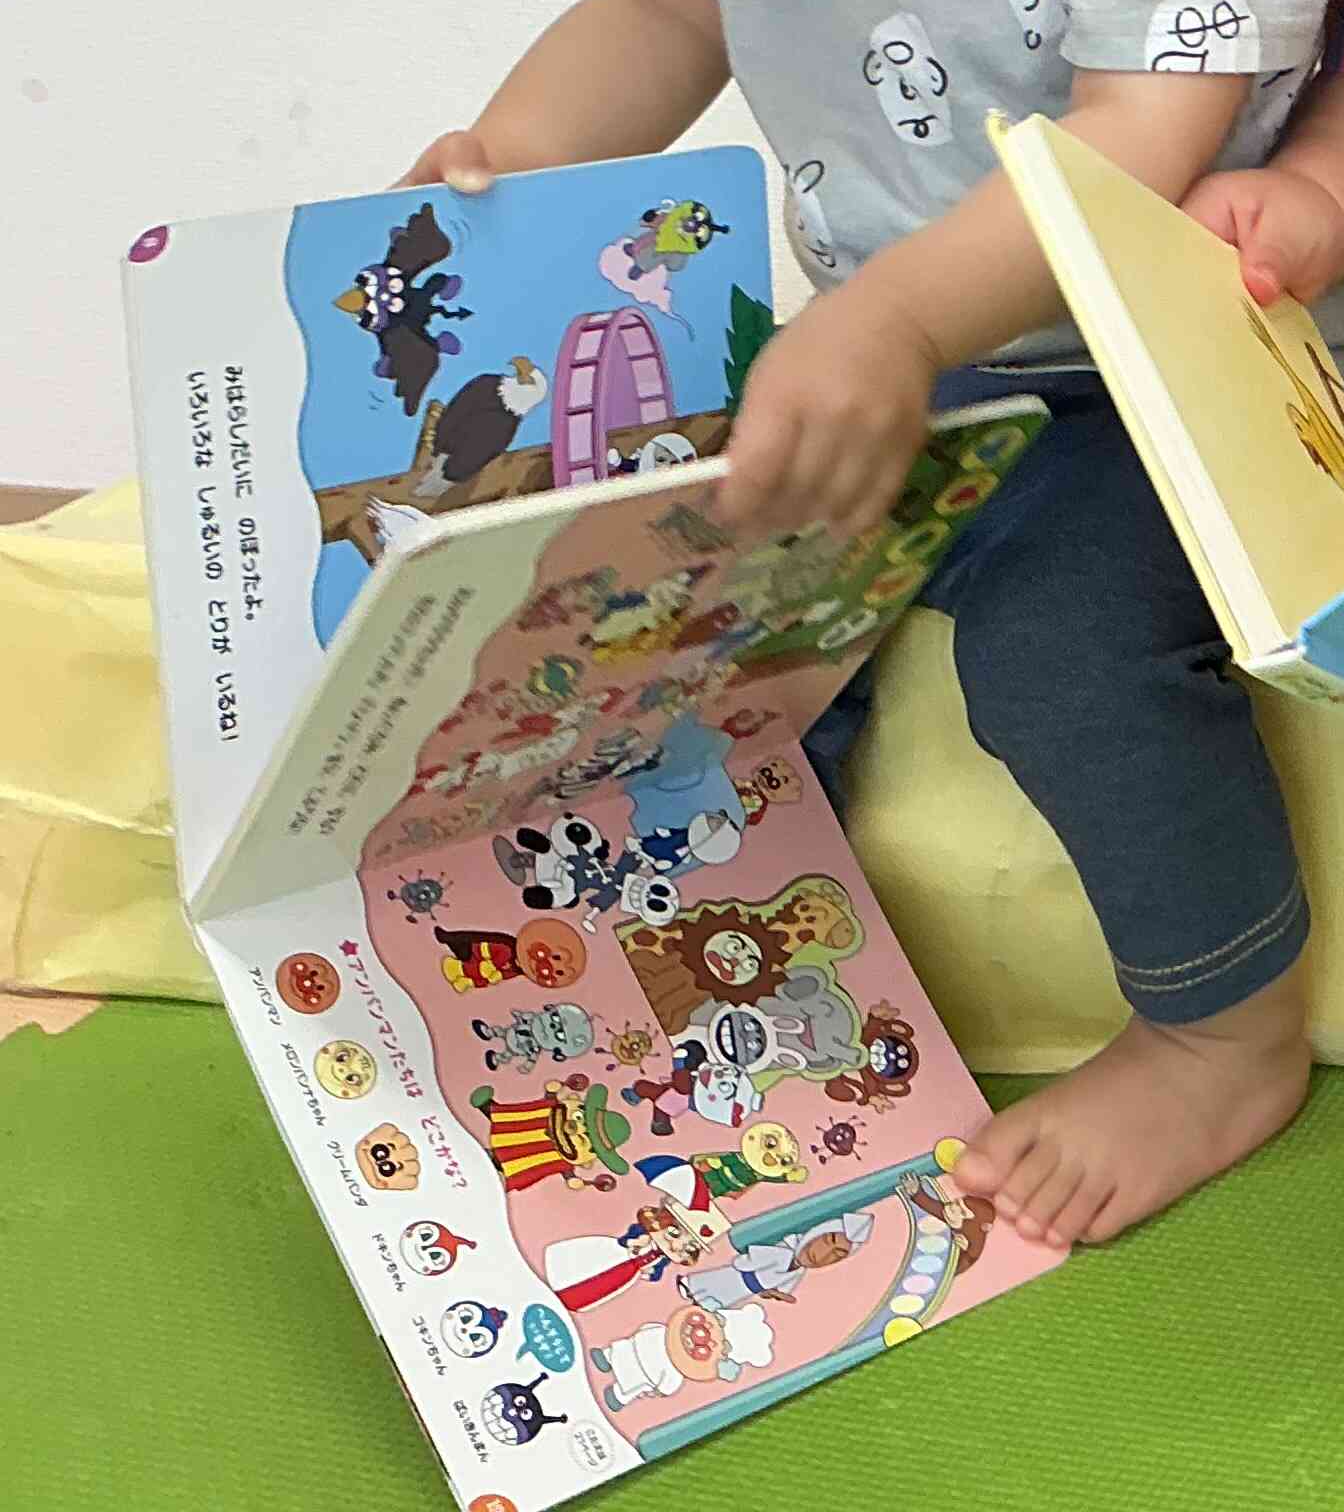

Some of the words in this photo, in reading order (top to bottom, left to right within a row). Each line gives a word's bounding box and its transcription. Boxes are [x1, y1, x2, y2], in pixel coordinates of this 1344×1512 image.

[187, 370, 214, 468] いろいろな
[224, 365, 253, 499] みはらしだいに
[197, 486, 225, 580] しゅるいの
[208, 599, 233, 655] とりが
[248, 966, 283, 1026] アンパンマン
[327, 1138, 369, 1208] クリームパンダ
[372, 1232, 406, 1293] ドキンちゃん
[453, 1399, 489, 1464] ばいきんまん
